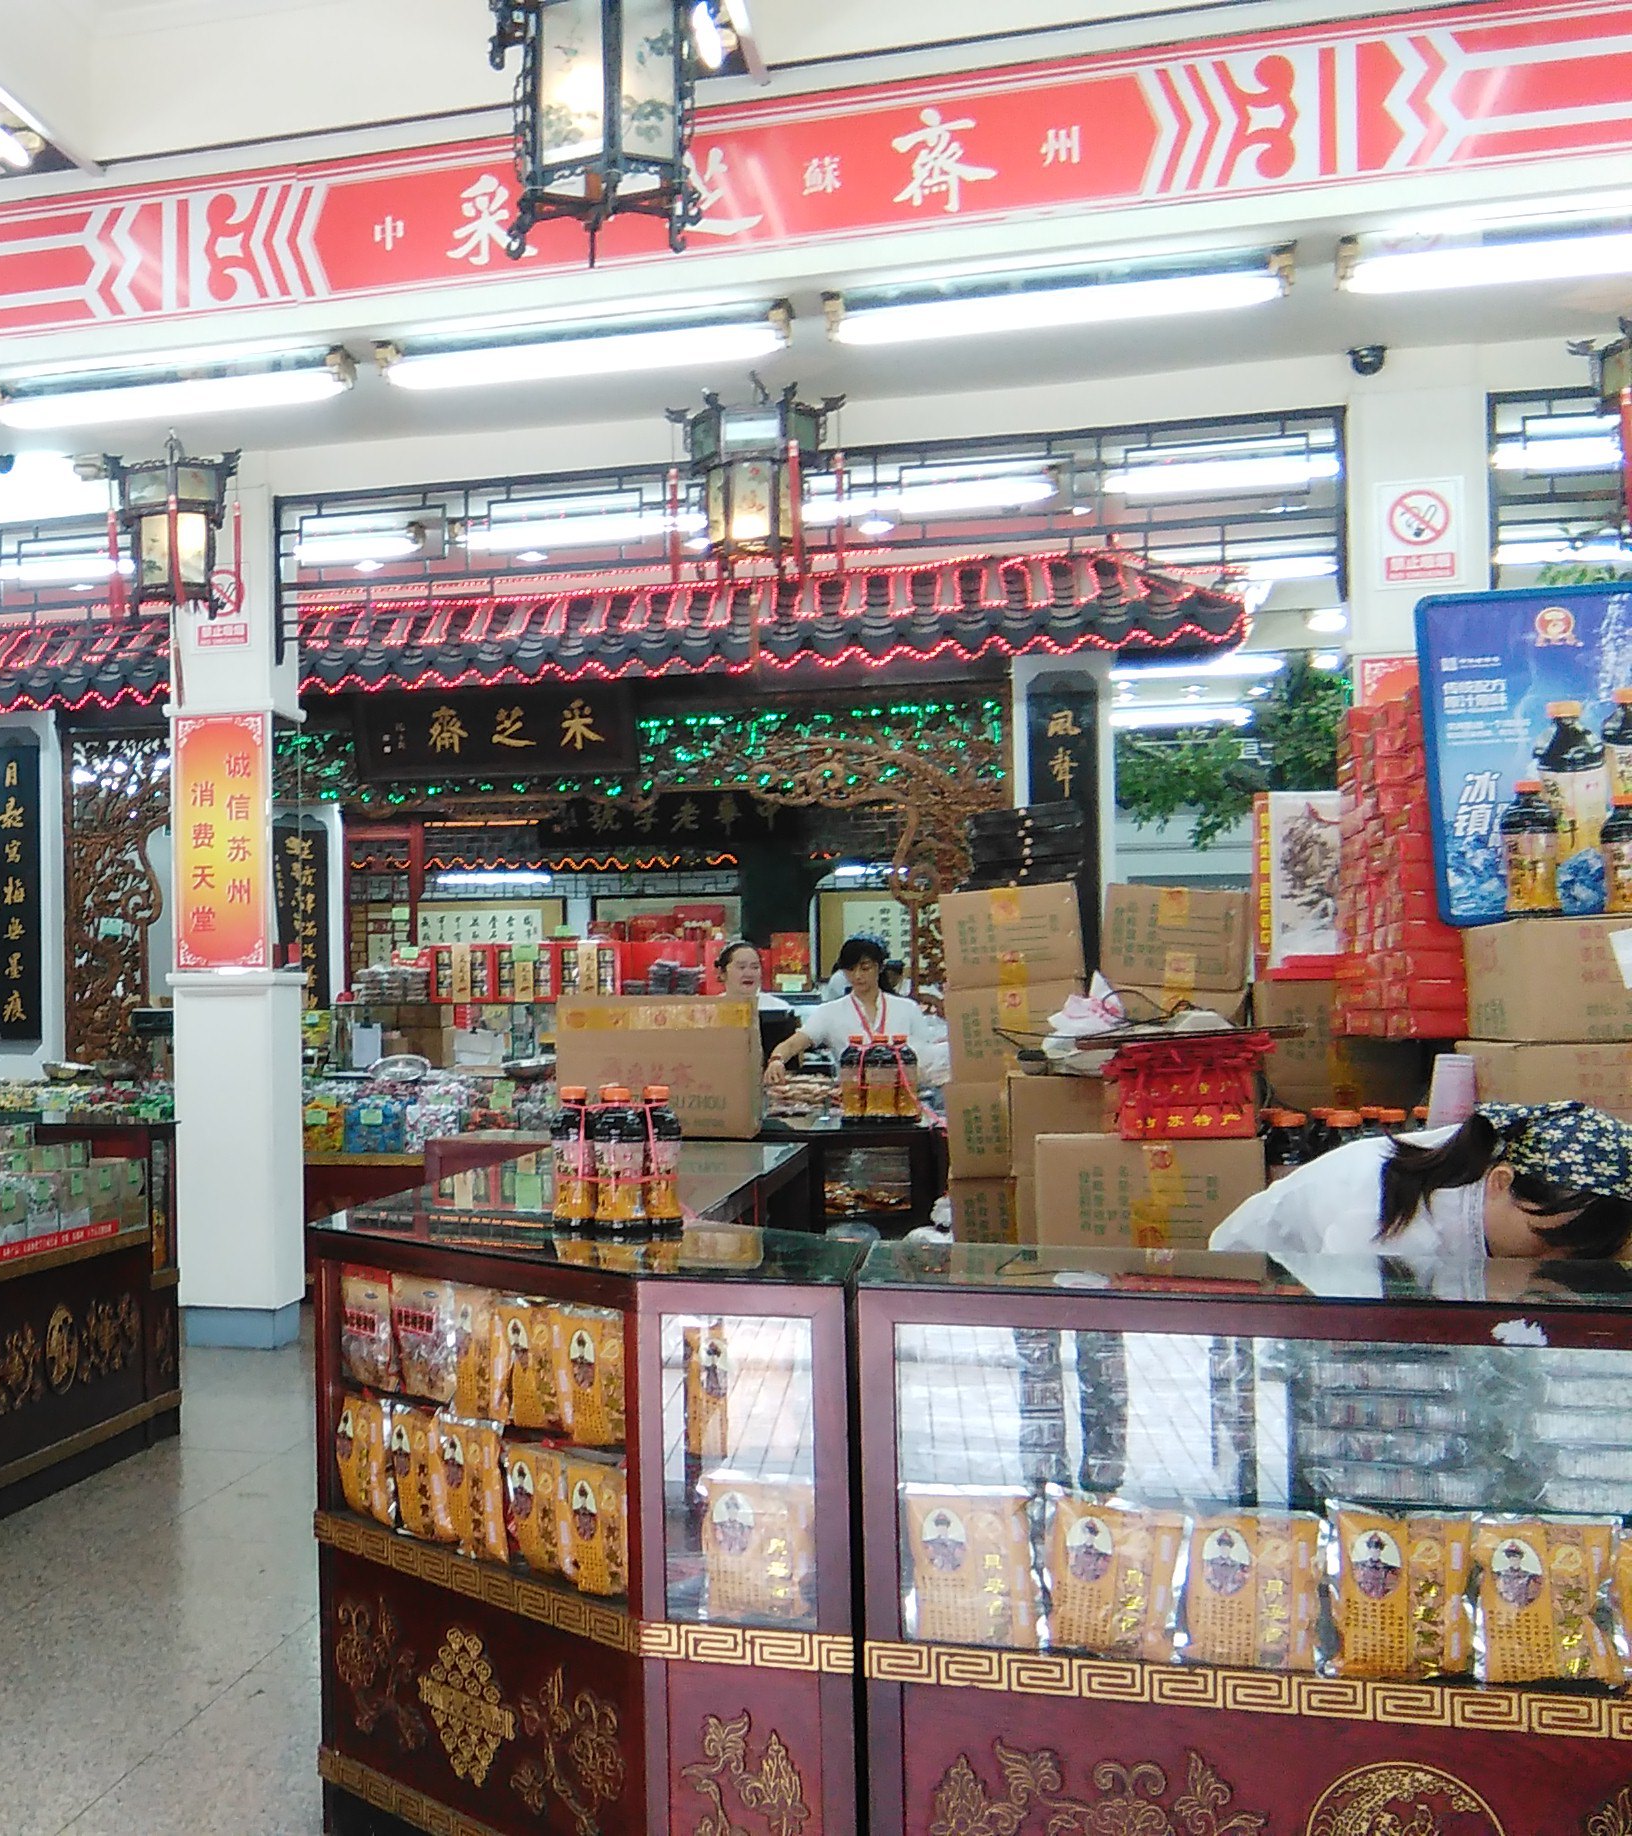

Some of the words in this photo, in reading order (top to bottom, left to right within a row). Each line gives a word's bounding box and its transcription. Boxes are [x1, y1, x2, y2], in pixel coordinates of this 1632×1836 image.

[190, 780, 216, 934] 消费天堂
[225, 752, 252, 905] 诚信苏州
